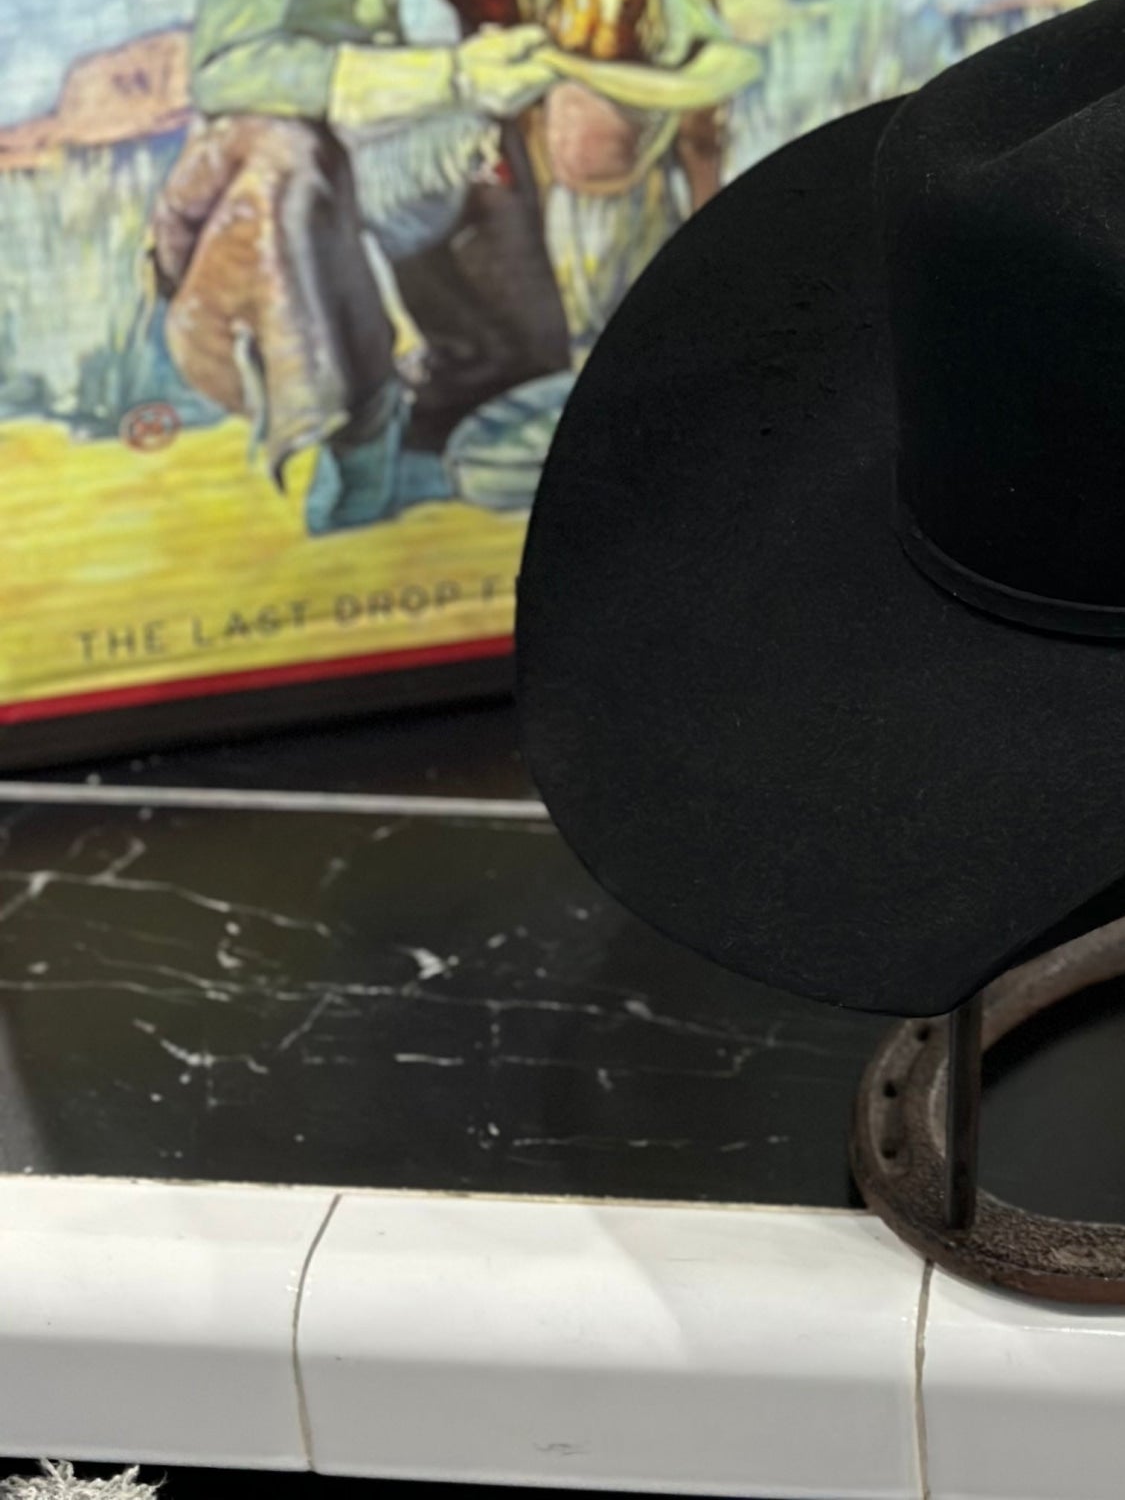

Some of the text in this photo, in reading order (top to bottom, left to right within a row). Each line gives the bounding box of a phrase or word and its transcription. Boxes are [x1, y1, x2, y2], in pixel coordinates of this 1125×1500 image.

[77, 620, 166, 661] THE
[192, 602, 309, 647] LAST
[334, 580, 462, 627] DROP
